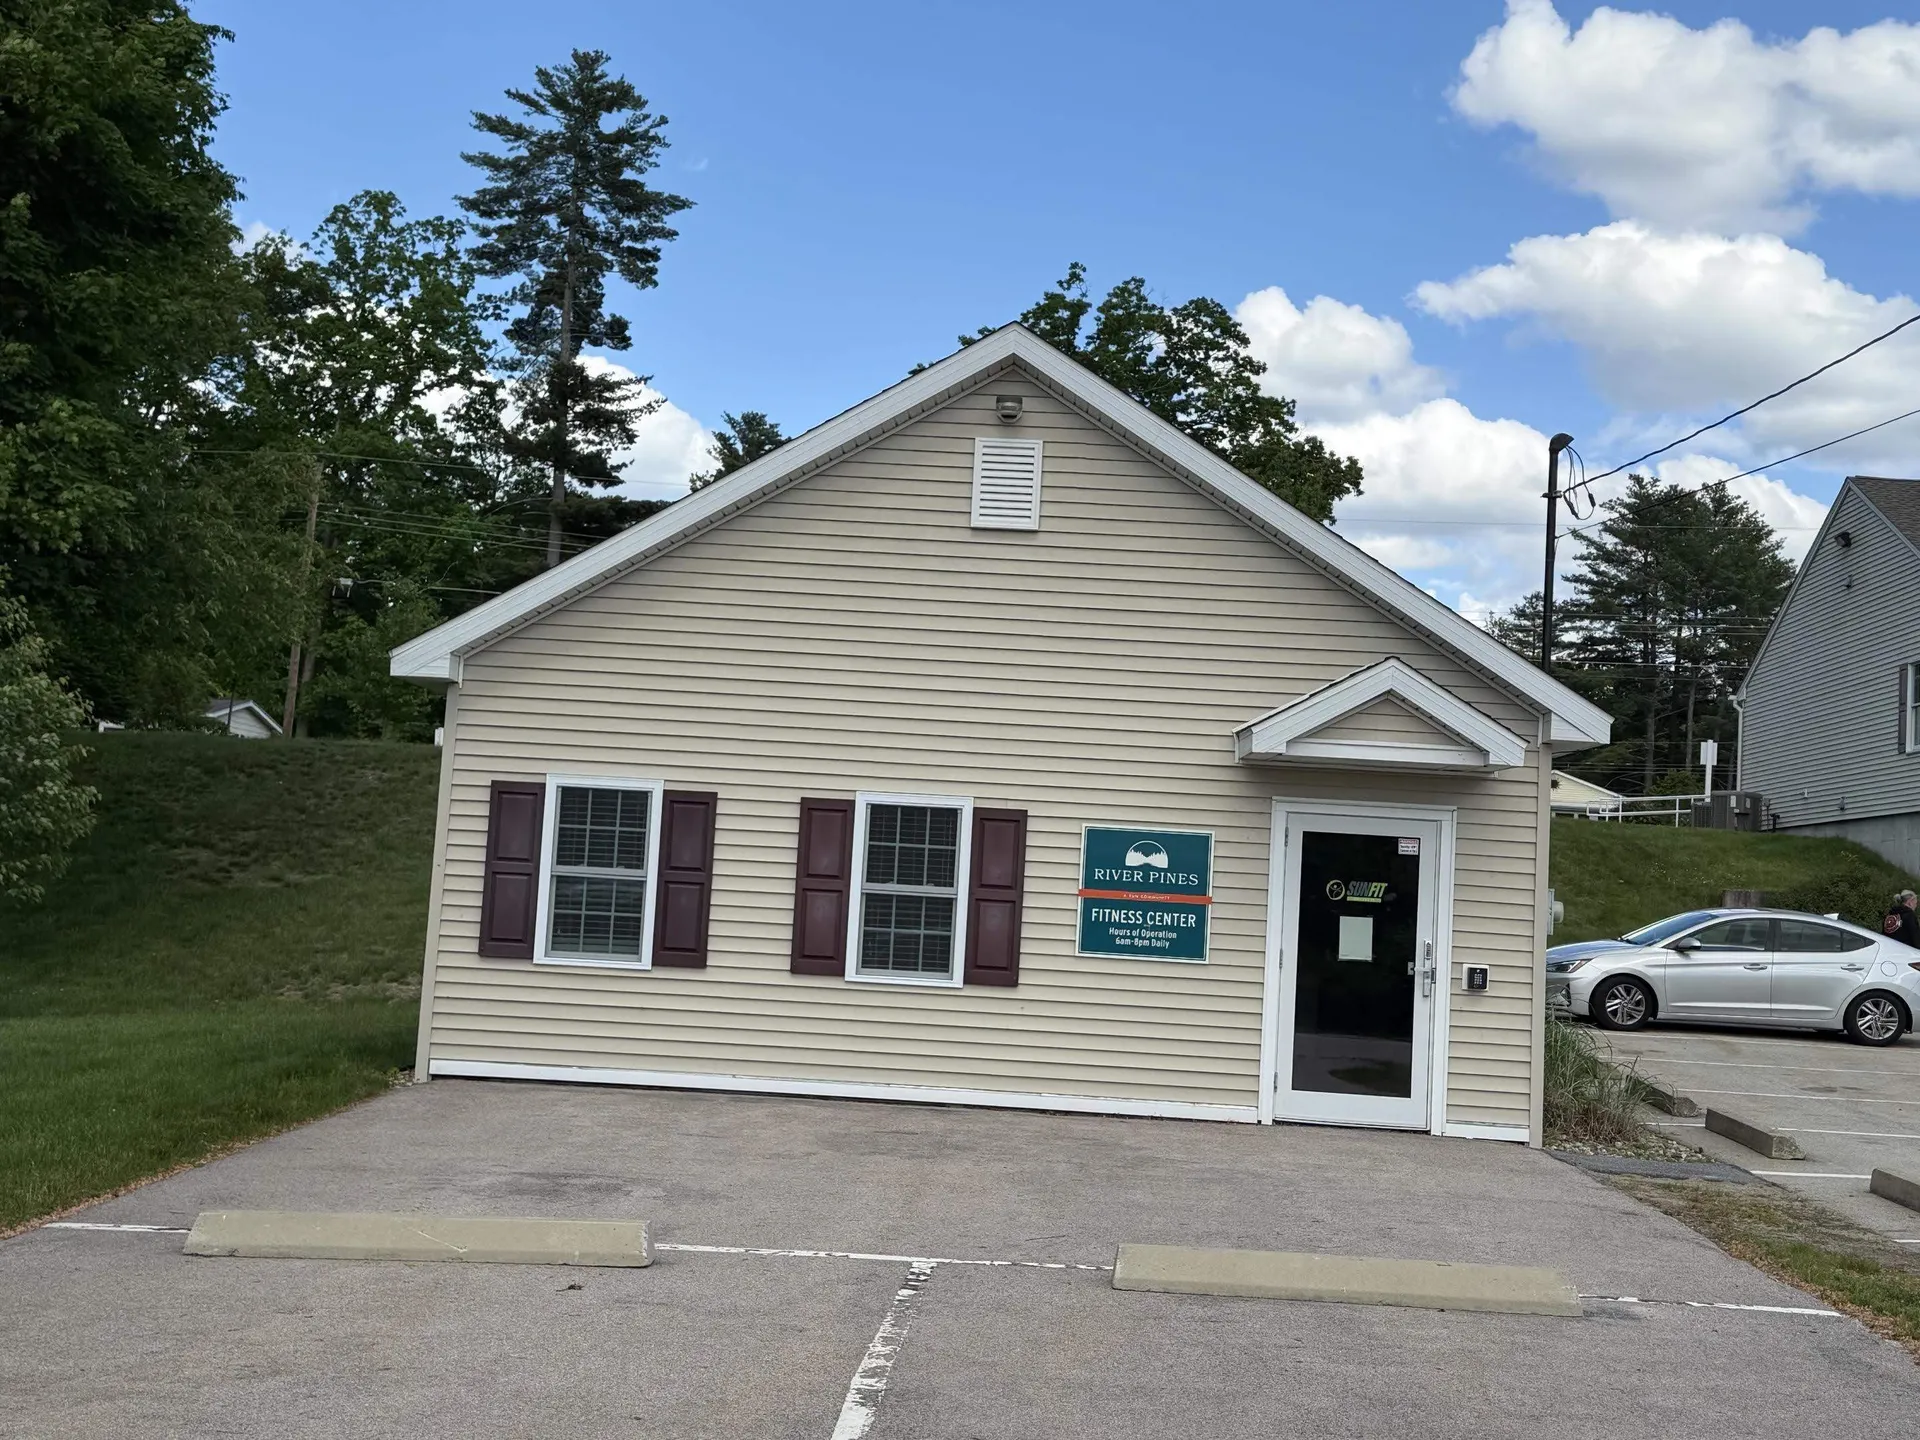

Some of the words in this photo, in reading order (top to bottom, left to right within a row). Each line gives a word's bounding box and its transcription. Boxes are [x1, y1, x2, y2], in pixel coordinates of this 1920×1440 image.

[1094, 868, 1144, 883] RIVER
[1149, 871, 1199, 886] PINES
[1346, 880, 1388, 897] SUNFIT
[1091, 908, 1143, 924] FITNESS
[1147, 911, 1197, 927] CENTER
[1109, 927, 1131, 937] Hours
[1132, 928, 1140, 937] of
[1141, 929, 1177, 940] Operation
[1115, 937, 1150, 948] 6am-8pm
[1151, 938, 1170, 949] Daily
